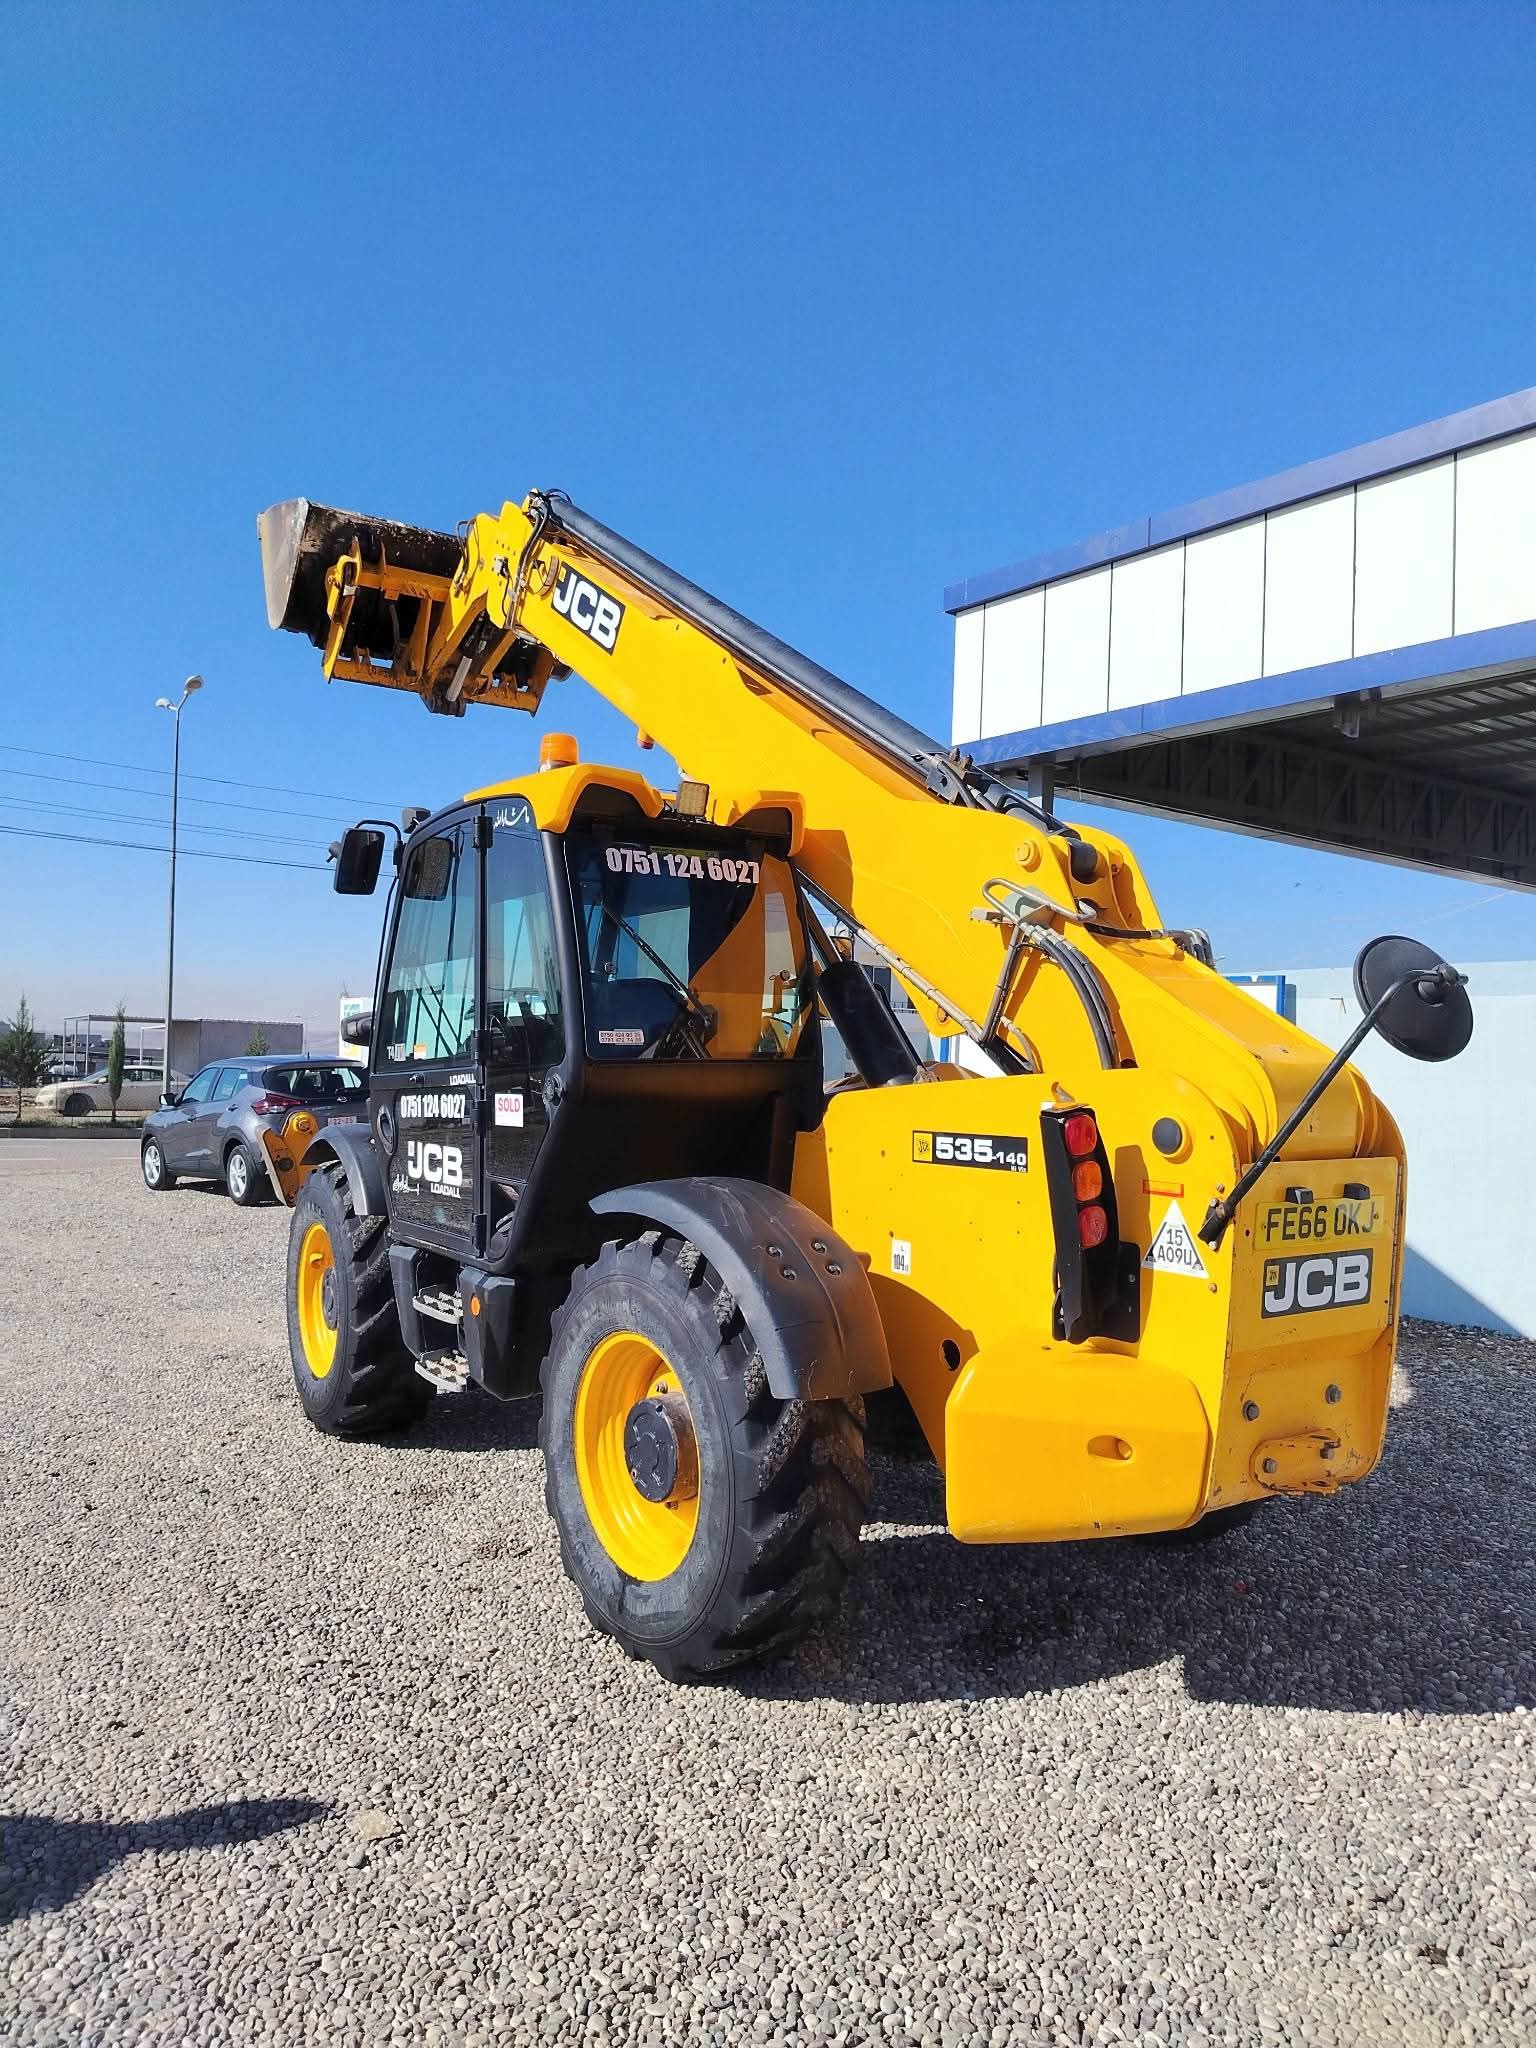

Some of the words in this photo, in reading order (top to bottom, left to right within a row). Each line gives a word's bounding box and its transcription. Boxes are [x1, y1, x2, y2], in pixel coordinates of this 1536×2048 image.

[553, 573, 621, 649] JCB
[606, 848, 661, 876] 0751
[663, 853, 705, 879] 124
[706, 857, 760, 884] 6027
[449, 1073, 477, 1086] LOADALL
[400, 1094, 421, 1119] 0751
[422, 1094, 440, 1118] 124
[440, 1093, 466, 1119] 6027
[498, 1097, 521, 1113] SOLD
[407, 1140, 463, 1187] JCB
[430, 1182, 462, 1199] LOADALL
[1265, 1205, 1328, 1242] FE66
[1166, 1228, 1183, 1246] 15
[893, 1253, 905, 1271] 104
[1157, 1244, 1193, 1266] A09U
[1264, 1254, 1370, 1313] JCB
